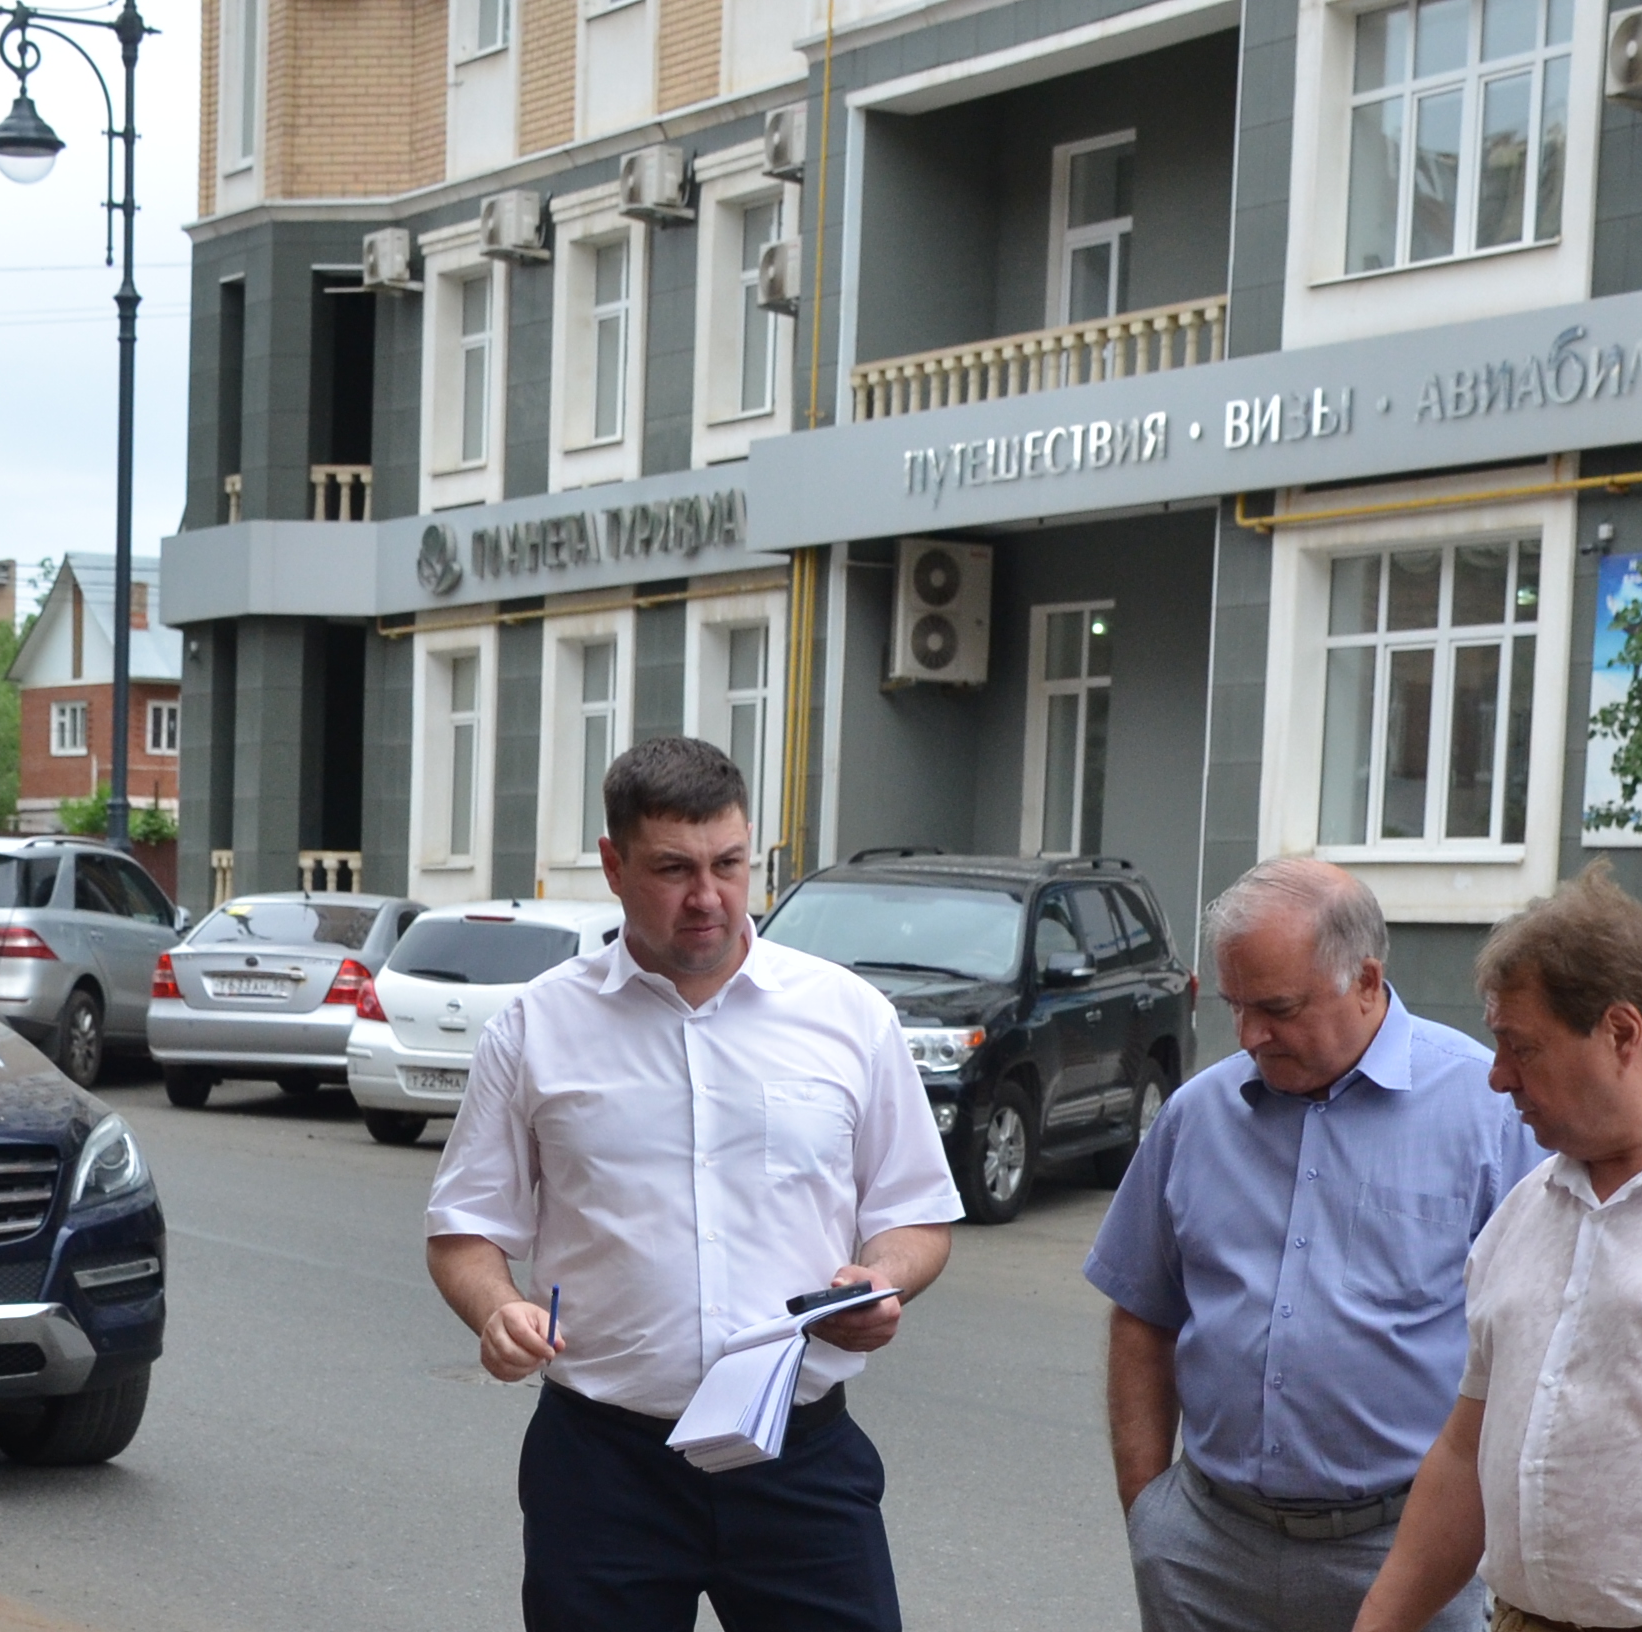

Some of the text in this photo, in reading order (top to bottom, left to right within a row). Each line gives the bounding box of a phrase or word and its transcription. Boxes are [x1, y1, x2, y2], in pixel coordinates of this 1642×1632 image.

[902, 411, 1167, 510] ПУТЕШЕСТВИЯ
[1224, 385, 1355, 451] ВИЗЫ
[470, 508, 602, 582] ПЛАНЕТА
